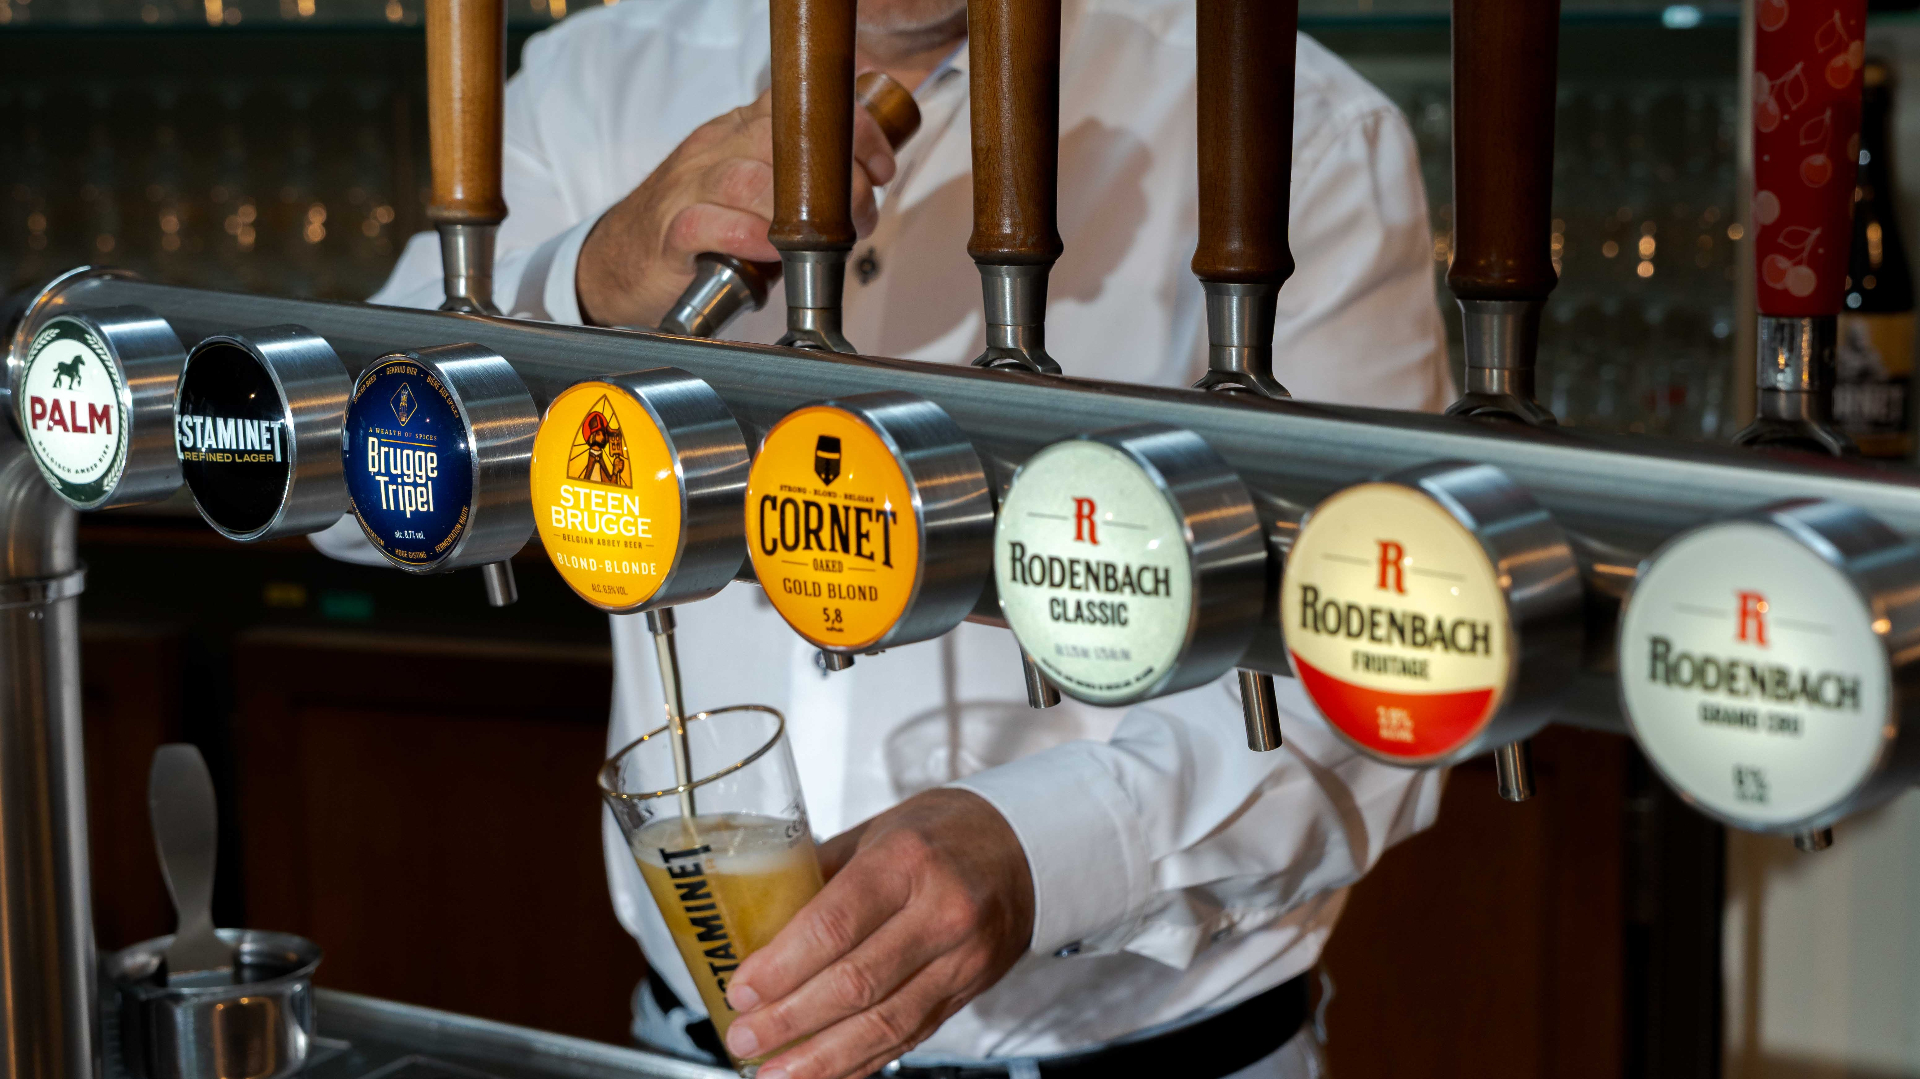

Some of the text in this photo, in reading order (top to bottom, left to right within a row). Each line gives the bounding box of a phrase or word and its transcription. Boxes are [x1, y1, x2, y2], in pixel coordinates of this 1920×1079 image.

[30, 395, 113, 435] PALM
[375, 427, 402, 437] WEALTH
[415, 433, 438, 441] SPICES
[184, 451, 274, 463] REFINED LAGER
[368, 436, 438, 484] Brugge
[375, 475, 434, 519] Tripel
[560, 484, 640, 516] STEEN
[779, 484, 875, 503] STRONG BLOND BELGIAN
[551, 506, 653, 538] BRUGGE
[760, 494, 897, 569] CORNET
[1071, 496, 1100, 546] R
[562, 533, 643, 549] BELGIAN ABBEY BEER
[556, 552, 657, 575] BLOND-BLONDE
[813, 558, 844, 573] OAKED
[1009, 541, 1171, 597] RODENBACH
[1374, 538, 1408, 596] R
[783, 577, 878, 602] GOLD BLOND
[822, 607, 843, 625] 5,8
[1050, 597, 1129, 627] CLASSIC
[1299, 584, 1492, 657] RODENBACH
[1735, 588, 1770, 650] R
[1648, 635, 1863, 714] RODENBACH
[658, 844, 741, 1011] TAMINET
